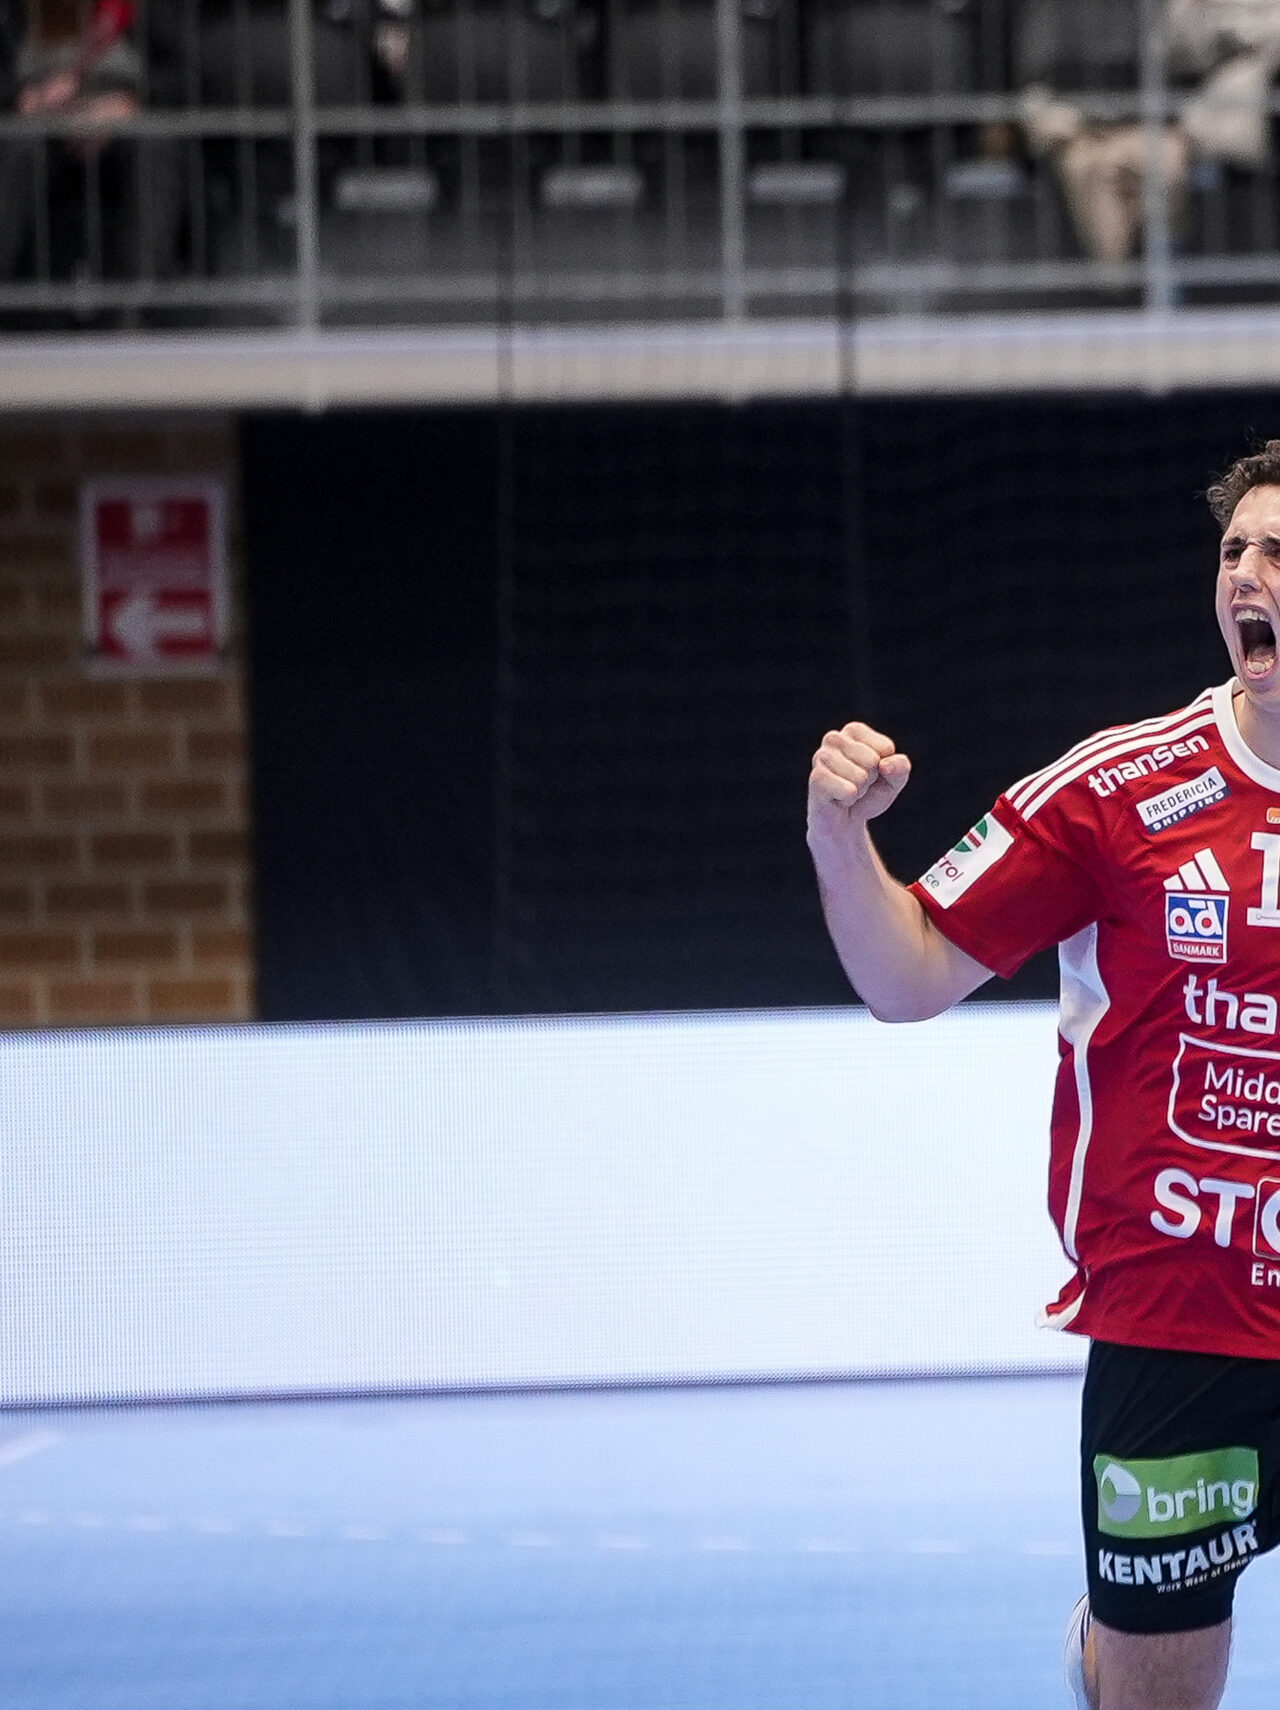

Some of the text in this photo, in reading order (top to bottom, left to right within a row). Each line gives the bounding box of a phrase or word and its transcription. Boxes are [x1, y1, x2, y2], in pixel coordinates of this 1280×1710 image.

[1087, 734, 1210, 798] thansen
[1146, 776, 1218, 818] FREDERICIA
[1152, 791, 1225, 831] SHIPPING
[1172, 942, 1221, 957] DANMARK
[1147, 1478, 1255, 1523] bring
[1099, 1524, 1258, 1585] KENTAUR
